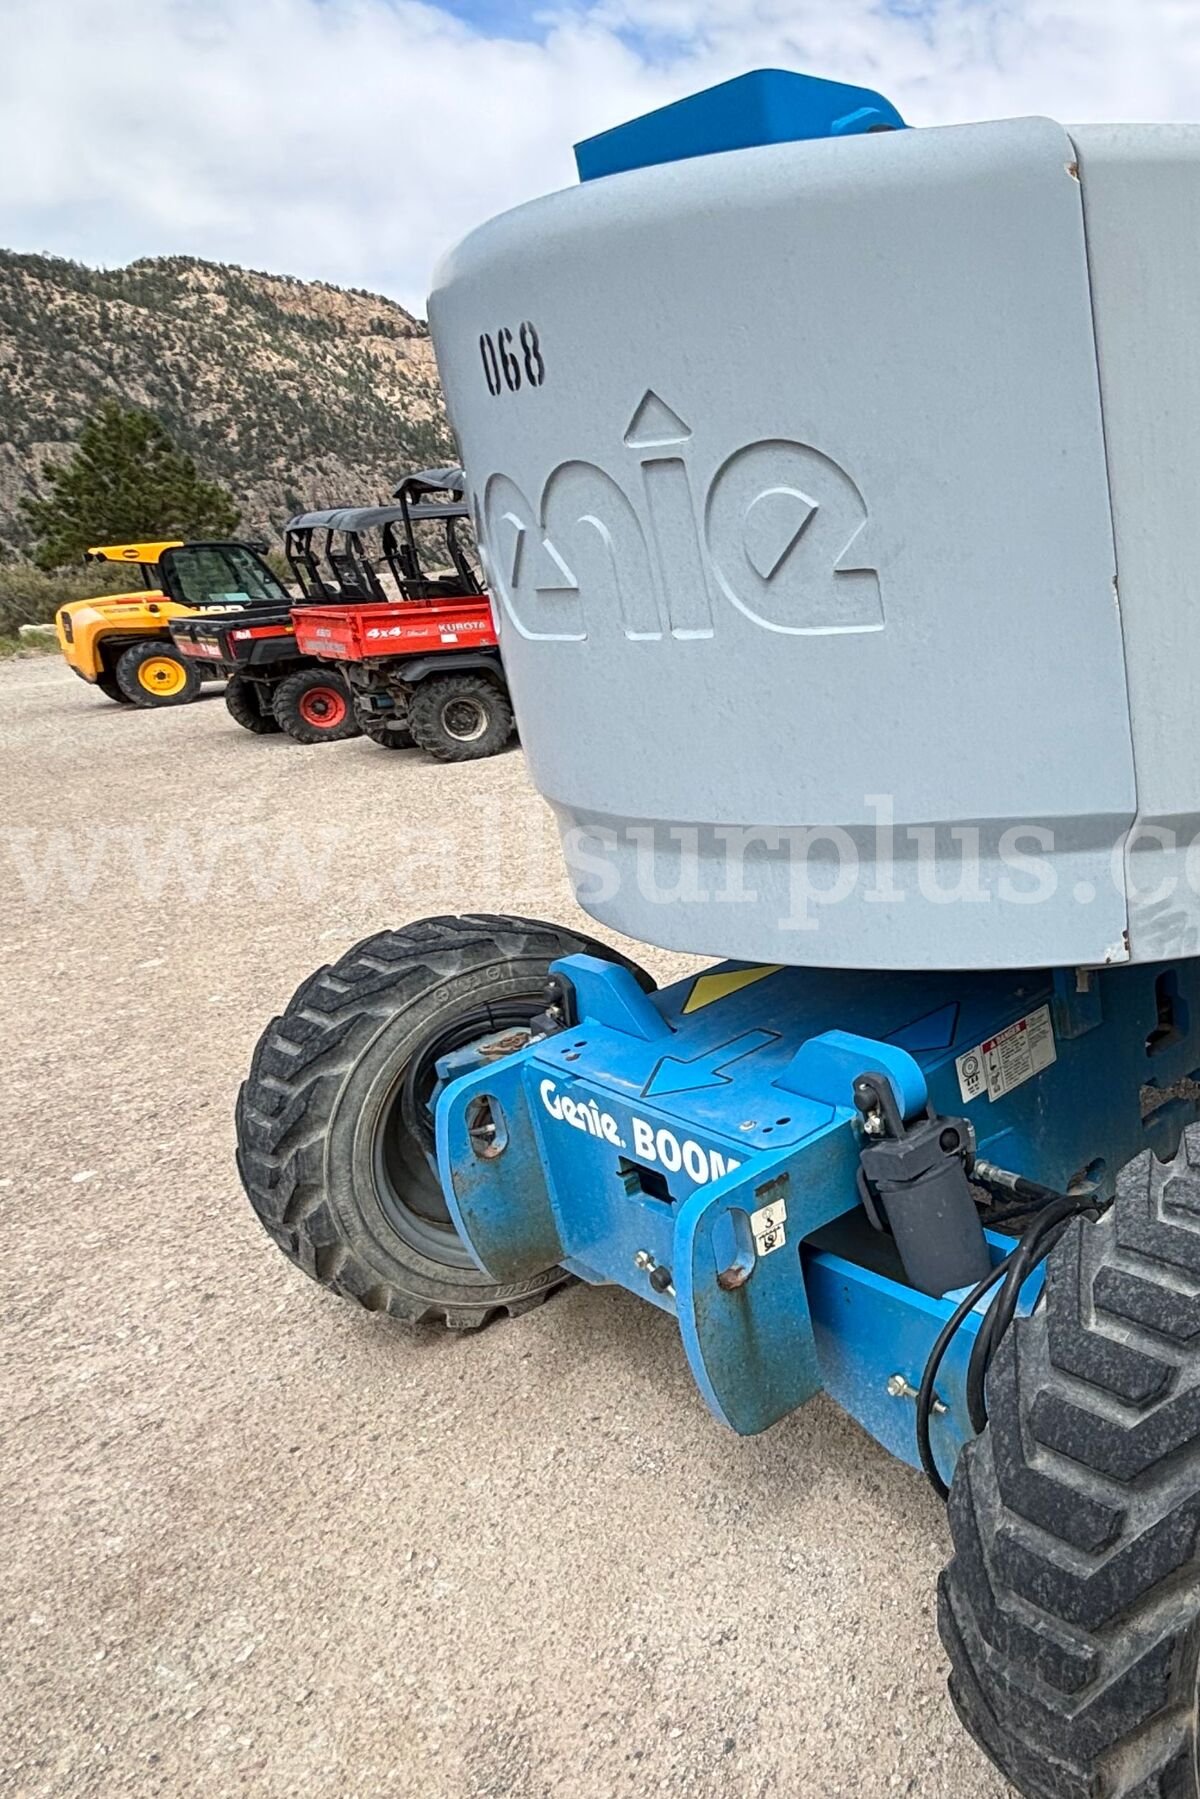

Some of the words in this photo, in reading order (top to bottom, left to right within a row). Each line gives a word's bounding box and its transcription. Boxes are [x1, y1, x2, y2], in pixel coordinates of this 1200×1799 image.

[479, 320, 545, 396] 068
[474, 388, 886, 642] enie
[366, 626, 402, 639] 4x4
[438, 621, 487, 633] KUBOTA
